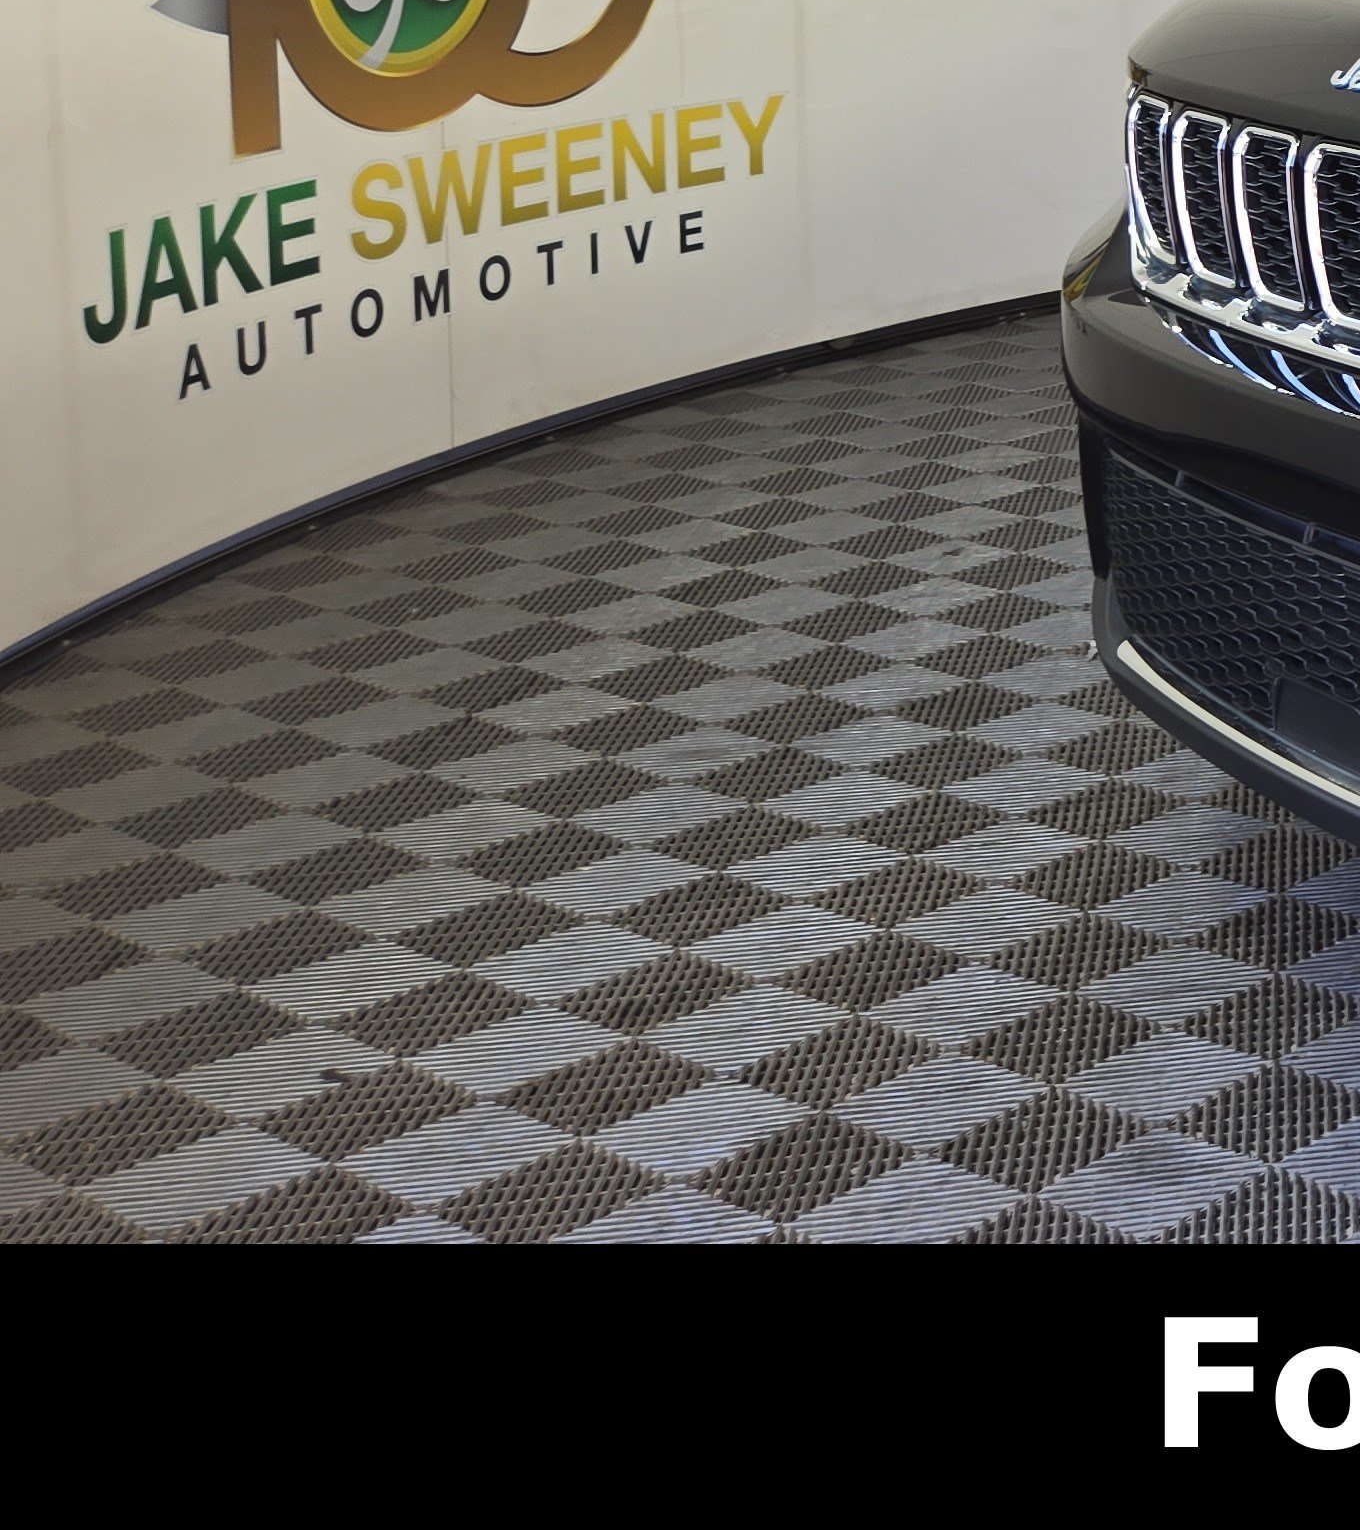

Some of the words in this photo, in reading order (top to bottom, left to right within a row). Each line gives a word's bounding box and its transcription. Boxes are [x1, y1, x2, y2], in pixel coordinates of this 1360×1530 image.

[82, 179, 321, 345] JAKE
[350, 95, 785, 261] SWEENEY
[178, 210, 705, 400] AUTOMOTIVE
